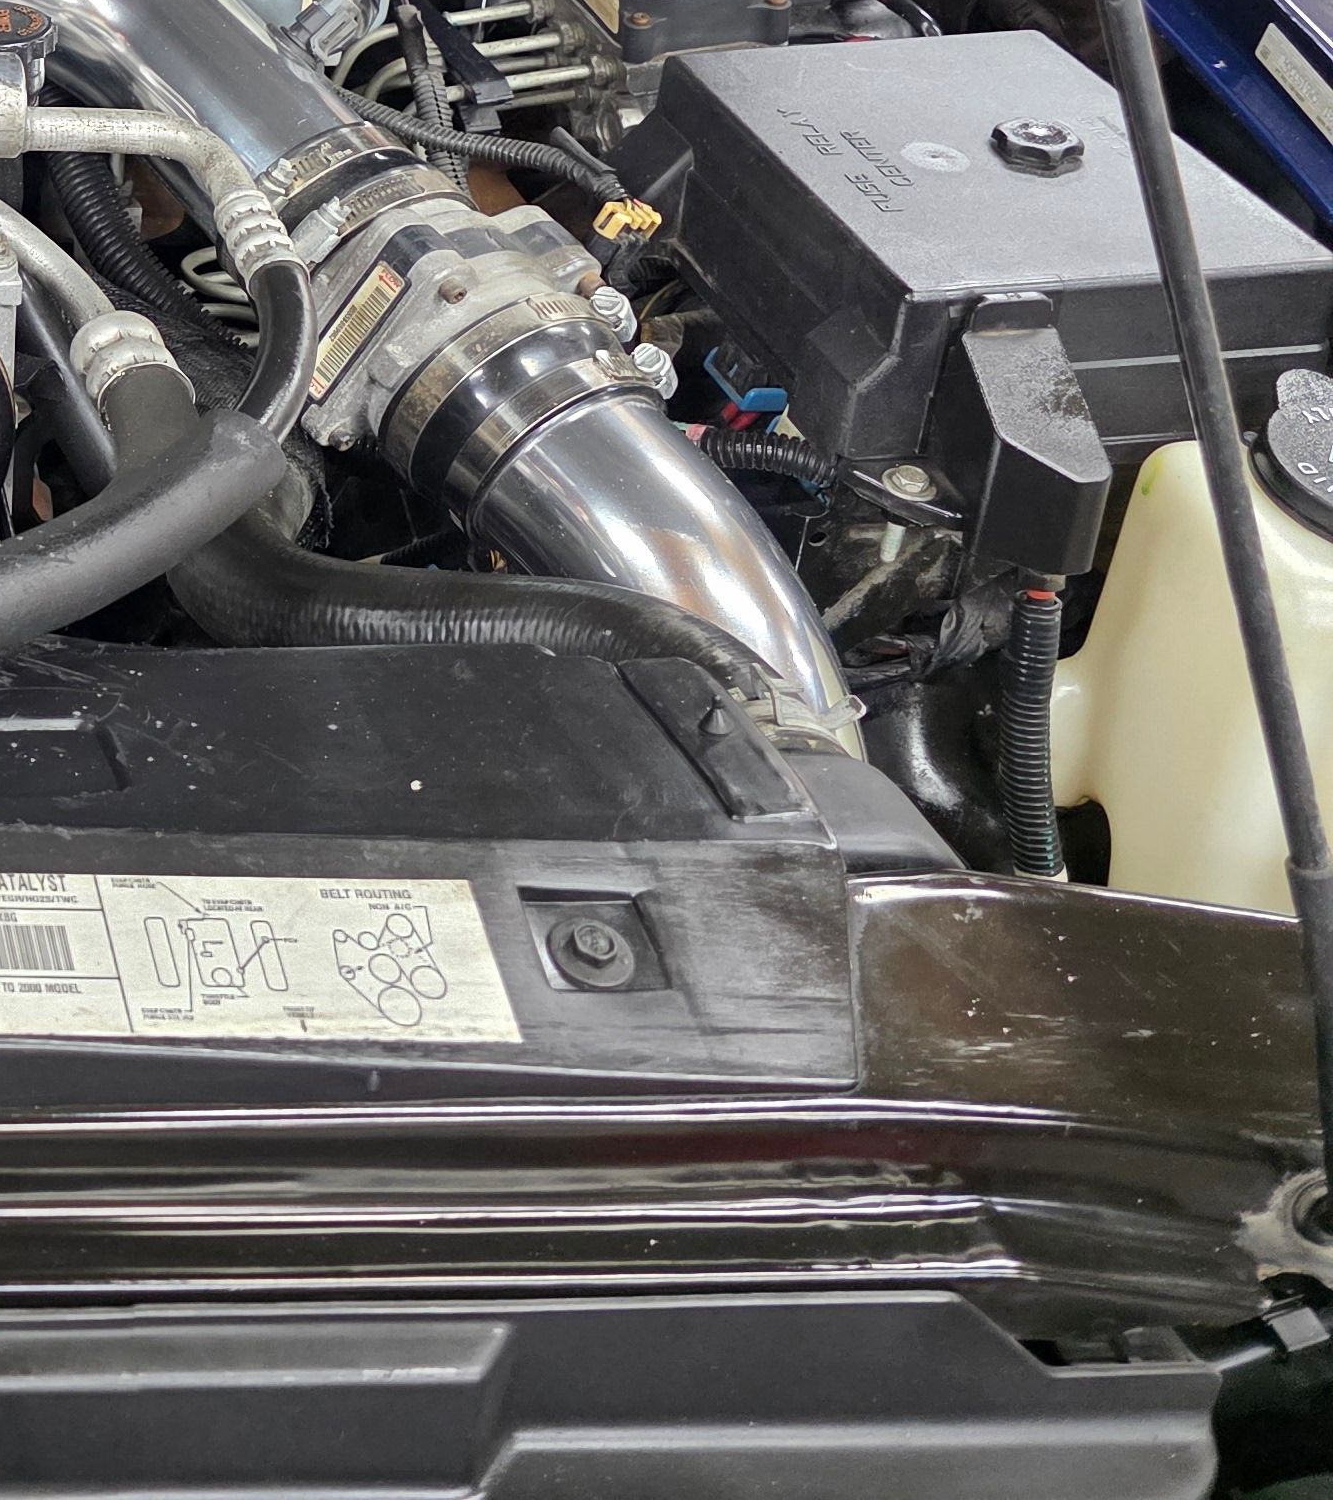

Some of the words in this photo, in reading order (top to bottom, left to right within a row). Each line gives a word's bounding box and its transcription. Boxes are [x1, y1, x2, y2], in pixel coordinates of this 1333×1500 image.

[775, 107, 845, 157] RELAY
[838, 129, 916, 188] CENTER
[844, 172, 906, 213] FUSE
[380, 267, 403, 290] FLOW
[319, 888, 350, 900] BELT
[354, 888, 412, 900] ROUTING
[1, 982, 16, 993] TO
[44, 982, 82, 994] MODEL
